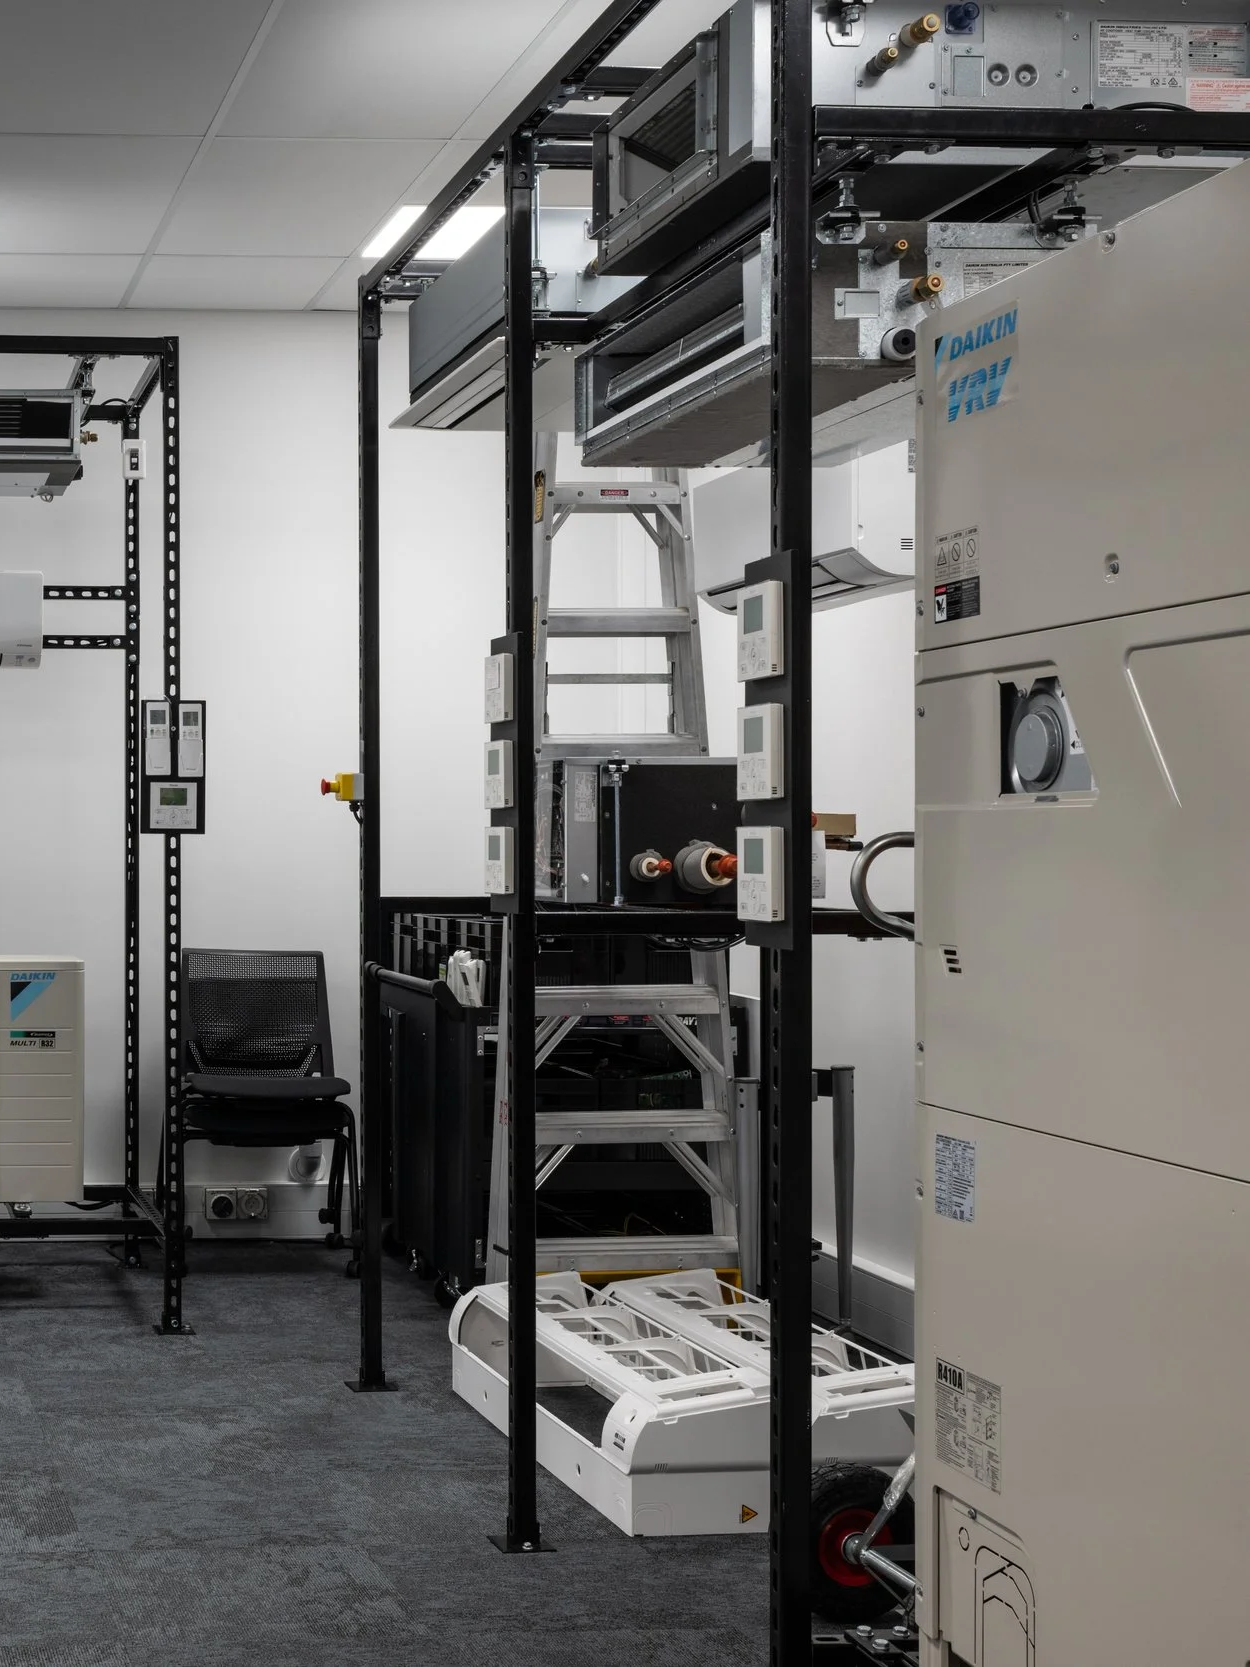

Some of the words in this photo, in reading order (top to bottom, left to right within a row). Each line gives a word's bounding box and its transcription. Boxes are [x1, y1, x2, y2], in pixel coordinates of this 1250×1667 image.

[949, 308, 1018, 361] DAIKIN
[947, 356, 1012, 423] VRV
[11, 972, 56, 981] DAIKIN
[937, 1361, 963, 1390] R410A
